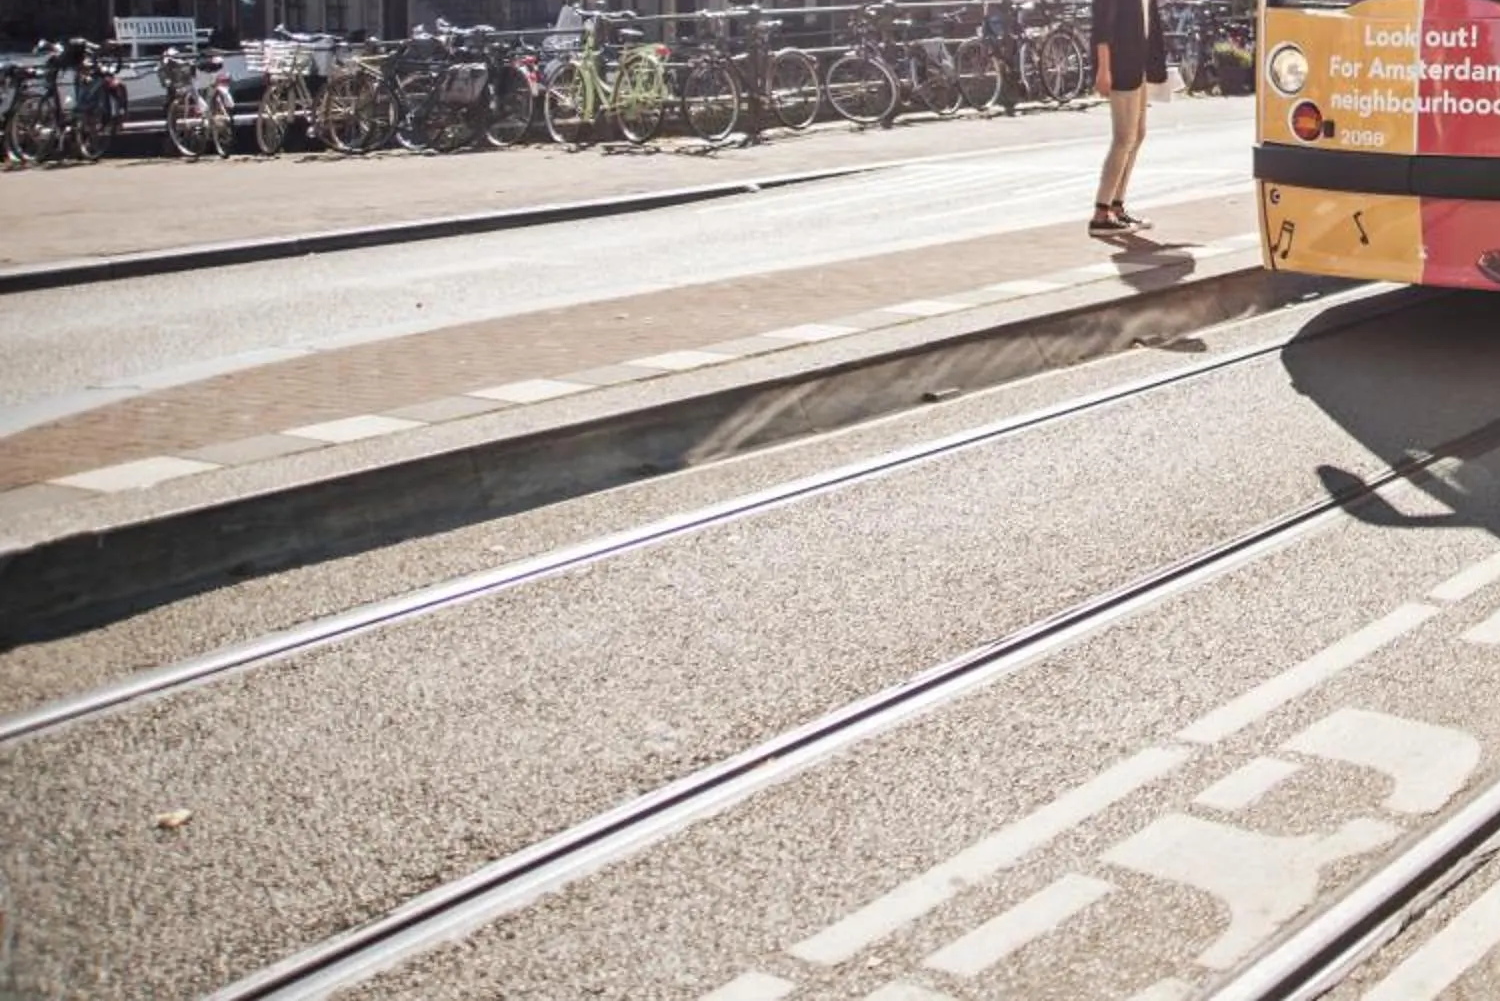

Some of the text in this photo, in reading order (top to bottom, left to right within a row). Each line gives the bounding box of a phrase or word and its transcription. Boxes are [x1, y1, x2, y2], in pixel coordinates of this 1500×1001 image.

[1364, 24, 1478, 48] Look out!
[1328, 55, 1363, 79] For
